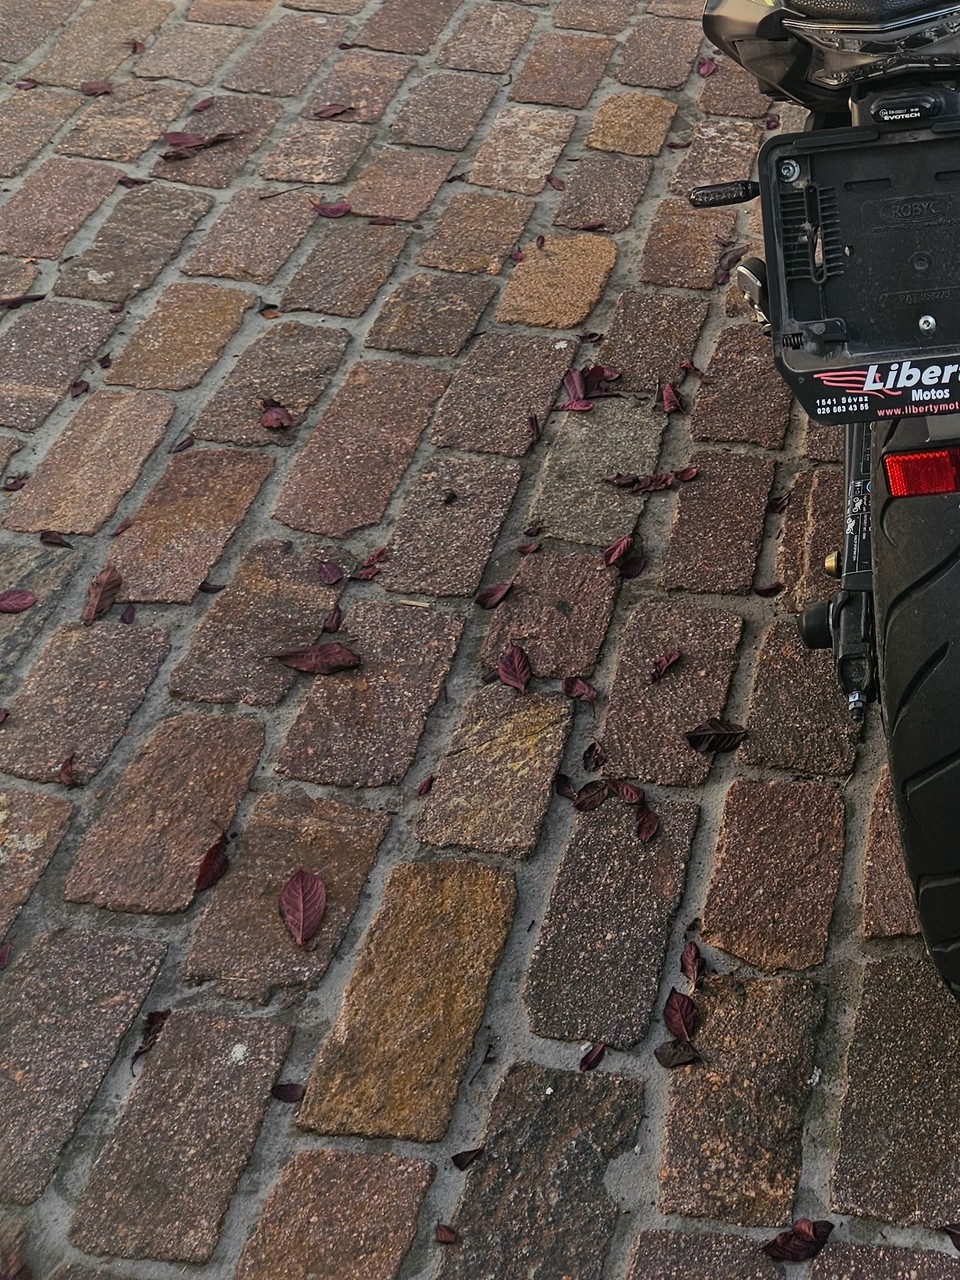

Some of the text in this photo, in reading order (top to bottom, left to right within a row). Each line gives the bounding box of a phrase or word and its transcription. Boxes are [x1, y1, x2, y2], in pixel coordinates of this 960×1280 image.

[884, 112, 920, 121] EVOTECH
[911, 388, 950, 402] Motos
[816, 397, 837, 406] 1541
[816, 407, 831, 415] 026
[848, 404, 858, 412] 43
[859, 403, 870, 411] 55
